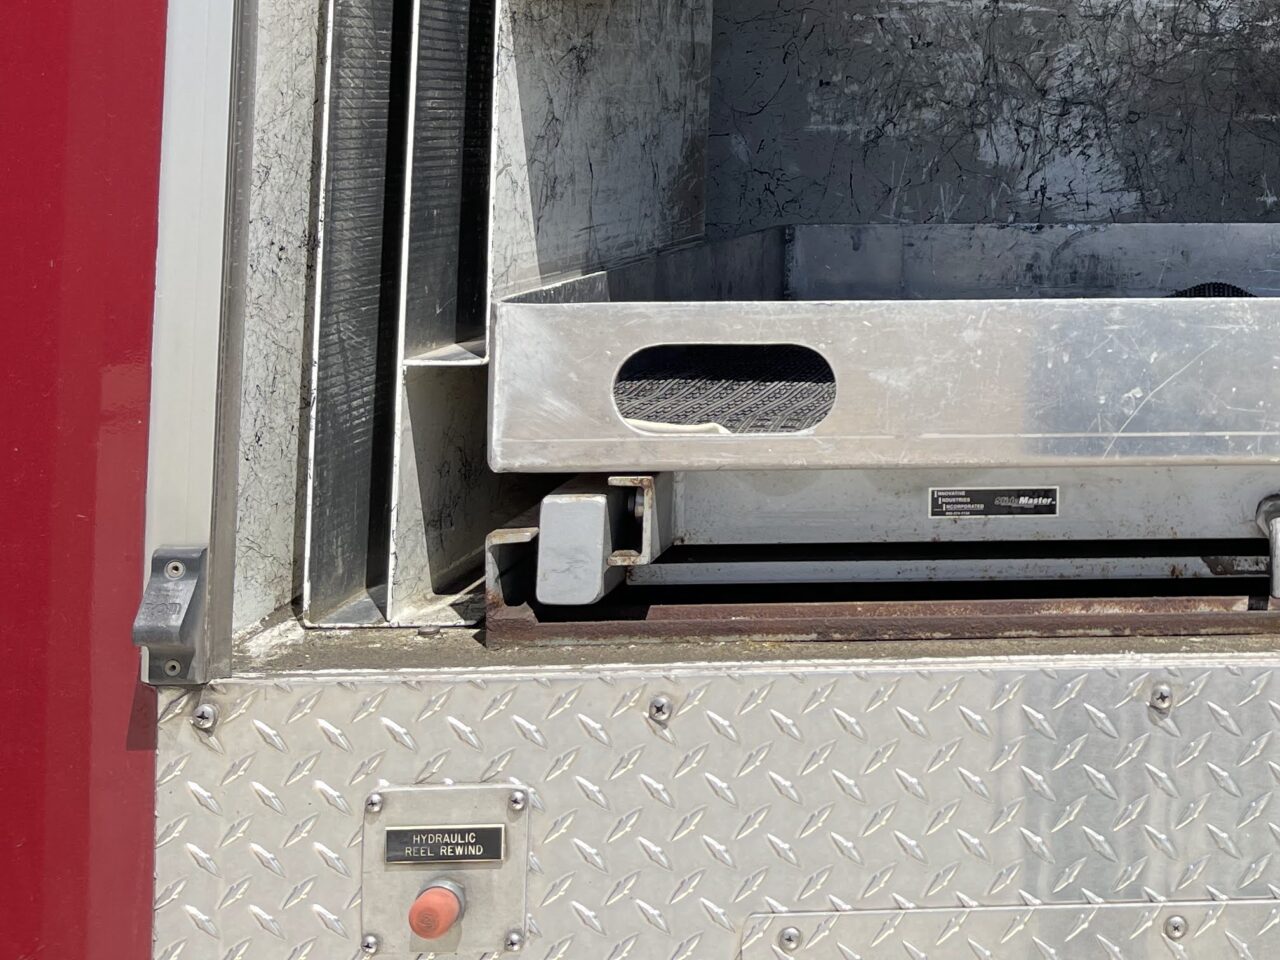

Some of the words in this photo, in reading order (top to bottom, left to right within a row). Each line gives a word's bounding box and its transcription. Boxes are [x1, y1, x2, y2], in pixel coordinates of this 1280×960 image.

[412, 832, 477, 844] HYDRAULIC
[405, 846, 434, 856] REEL
[439, 844, 484, 856] REWIND
